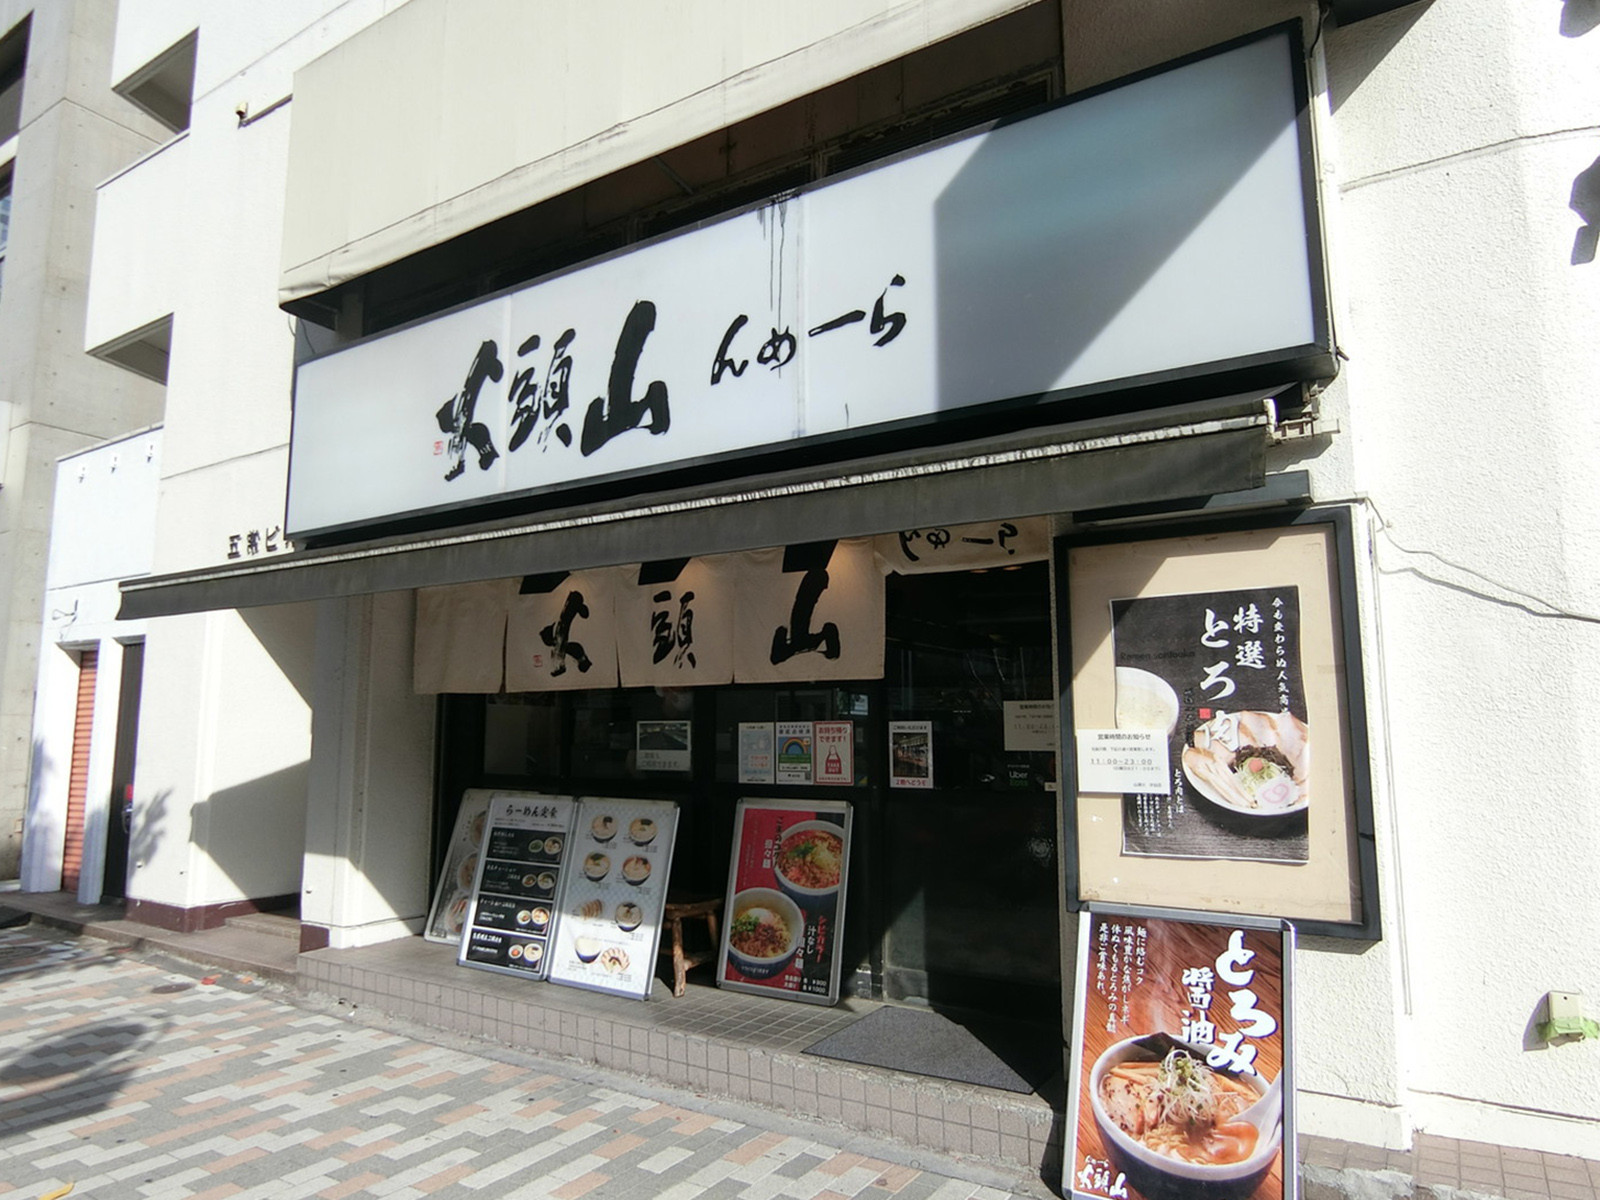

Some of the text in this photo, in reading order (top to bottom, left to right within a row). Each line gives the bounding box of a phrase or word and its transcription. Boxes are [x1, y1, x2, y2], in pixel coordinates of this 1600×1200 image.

[1232, 603, 1267, 670] 特選
[1097, 733, 1151, 741] 営業時間のお知らせ
[1009, 770, 1028, 779] Uber
[806, 925, 817, 954] 汁なし
[1205, 930, 1278, 1077] とろみ
